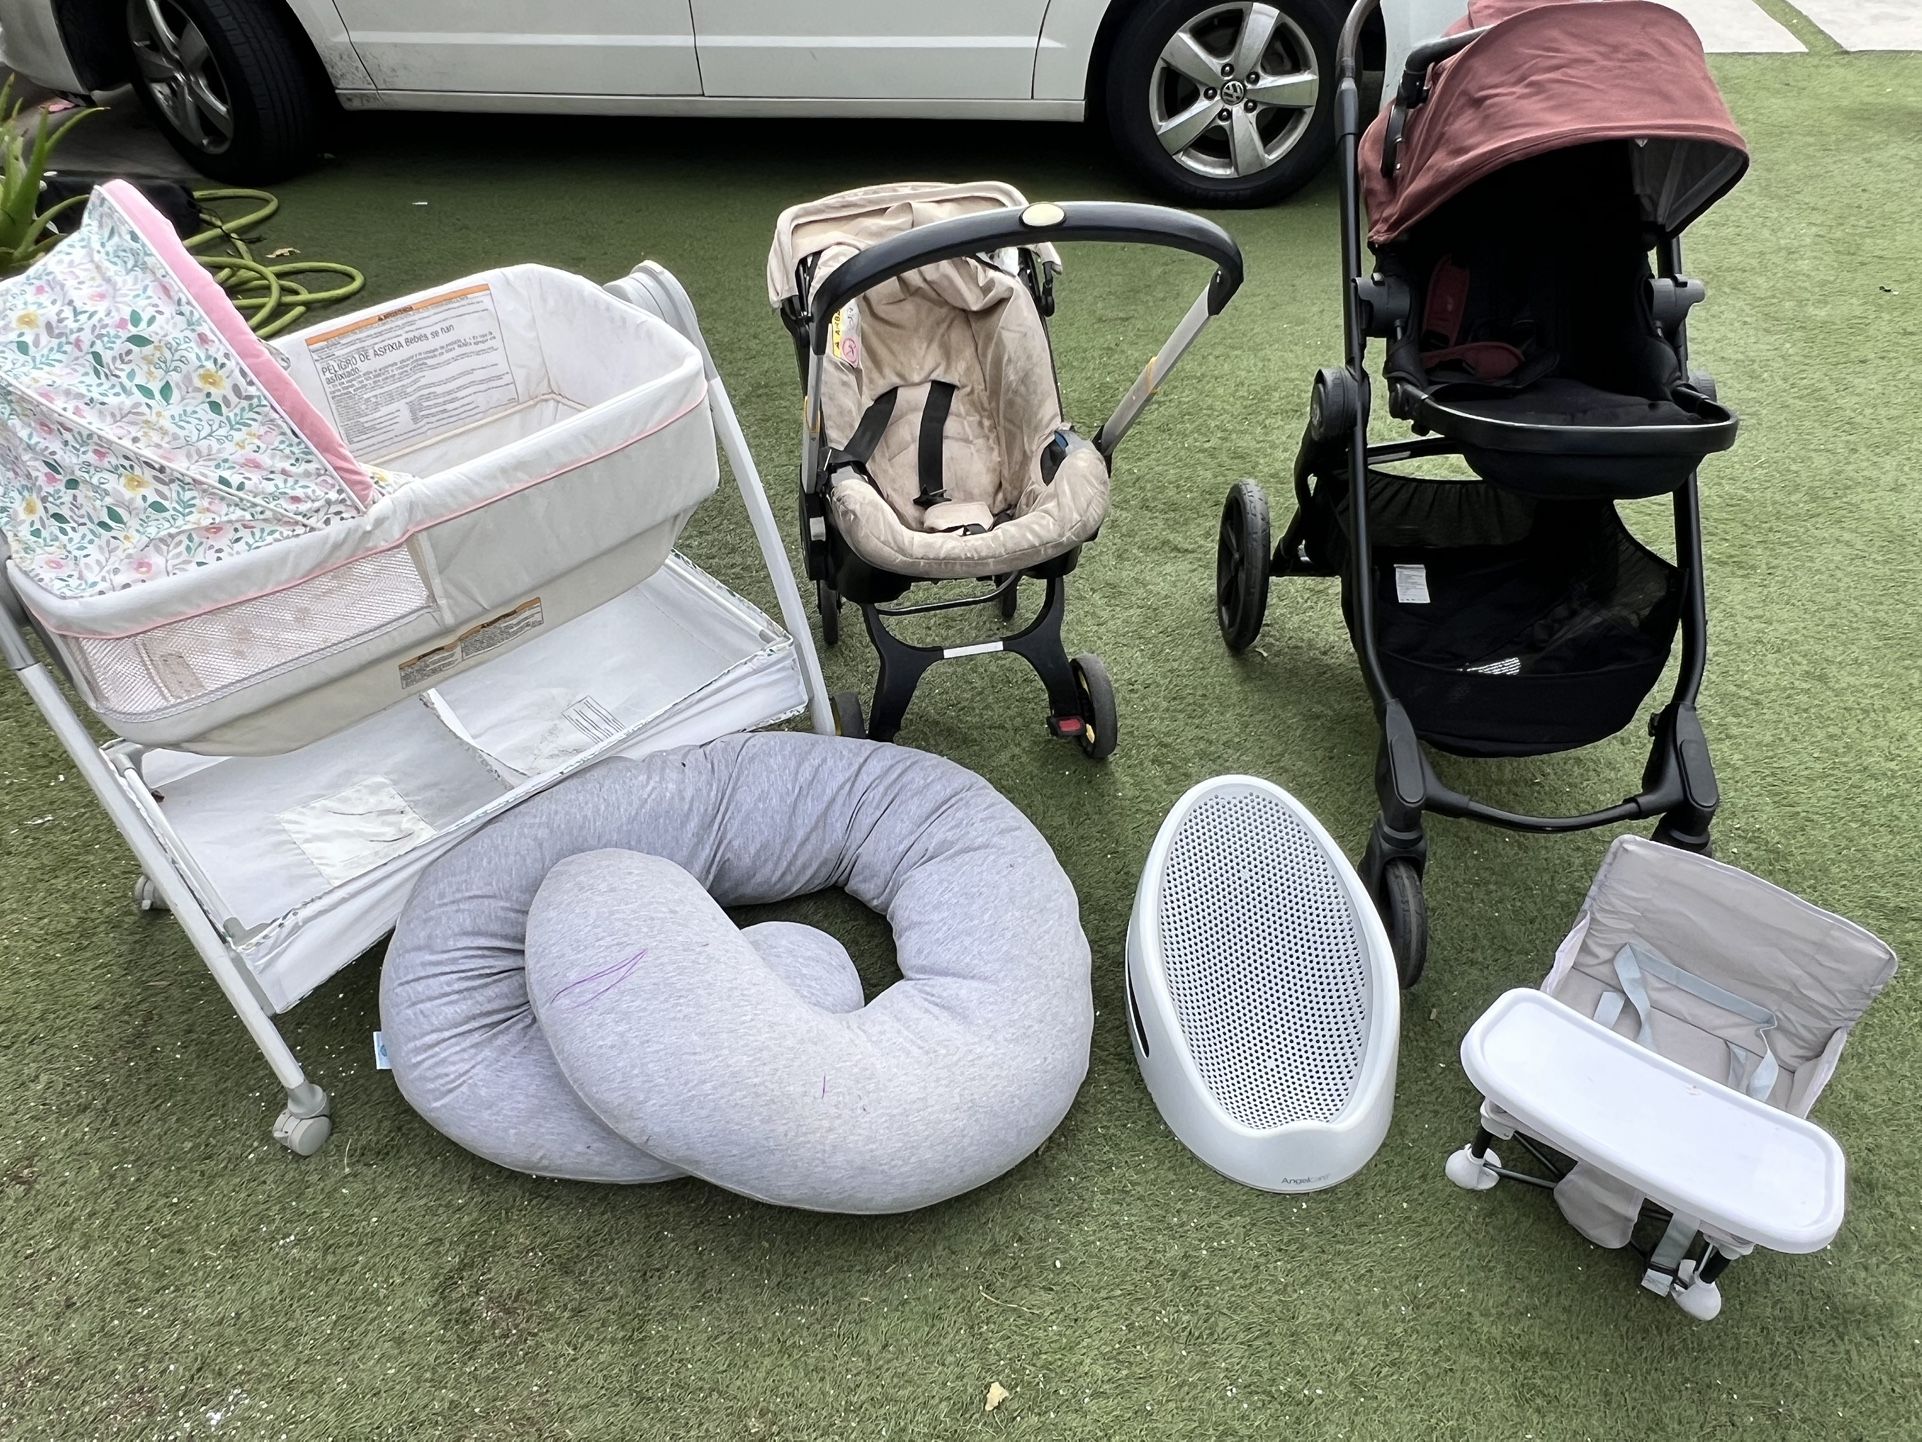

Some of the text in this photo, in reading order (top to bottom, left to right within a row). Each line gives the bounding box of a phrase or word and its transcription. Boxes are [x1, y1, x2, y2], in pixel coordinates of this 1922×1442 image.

[321, 354, 358, 376] PELIGRO
[358, 351, 371, 363] DE
[373, 340, 404, 358] ASFIXIA
